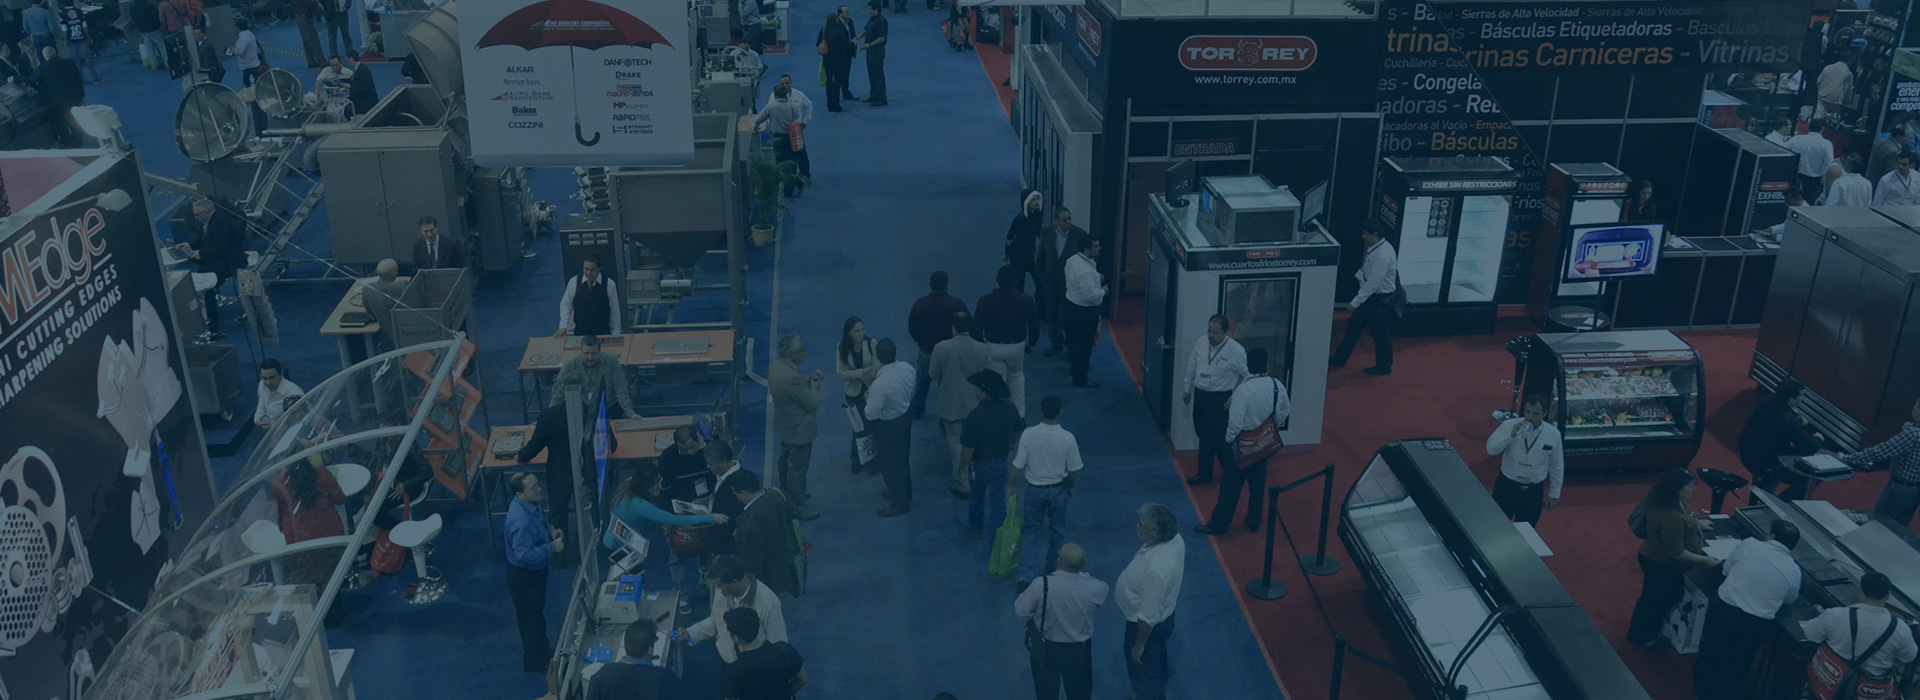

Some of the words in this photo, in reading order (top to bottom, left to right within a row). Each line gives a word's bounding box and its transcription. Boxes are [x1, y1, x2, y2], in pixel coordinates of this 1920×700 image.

[1461, 9, 1497, 20] Sierras
[1498, 8, 1510, 19] de
[1511, 8, 1532, 19] Alta
[1534, 7, 1580, 19] Velocidad
[1623, 7, 1636, 17] de
[1636, 6, 1656, 17] Alta
[1480, 22, 1556, 40] Básculas
[1559, 20, 1673, 41] Etiquetadoras
[1185, 47, 1235, 61] TOR
[1261, 47, 1310, 61] REY
[1535, 41, 1674, 68] Carniceras
[1698, 39, 1790, 64] Vitrinas
[1384, 57, 1437, 69] Cuchillería
[615, 70, 641, 79] DRAKE
[1194, 74, 1297, 86] www.torrey.com.mx
[512, 106, 537, 114] Baker
[613, 101, 626, 109] MP
[508, 121, 544, 129] COZZINI
[1430, 119, 1440, 130] al
[1430, 130, 1519, 151] Básculas
[1174, 142, 1235, 156] ENTRADA
[1422, 181, 1448, 189] EXHIBE
[1449, 181, 1461, 189] SIN
[1208, 258, 1317, 270] www.cuartosfriostorrey.com
[16, 299, 75, 360] CUTTING
[78, 263, 118, 307] EDGES
[65, 284, 123, 346] SOLUTIONS
